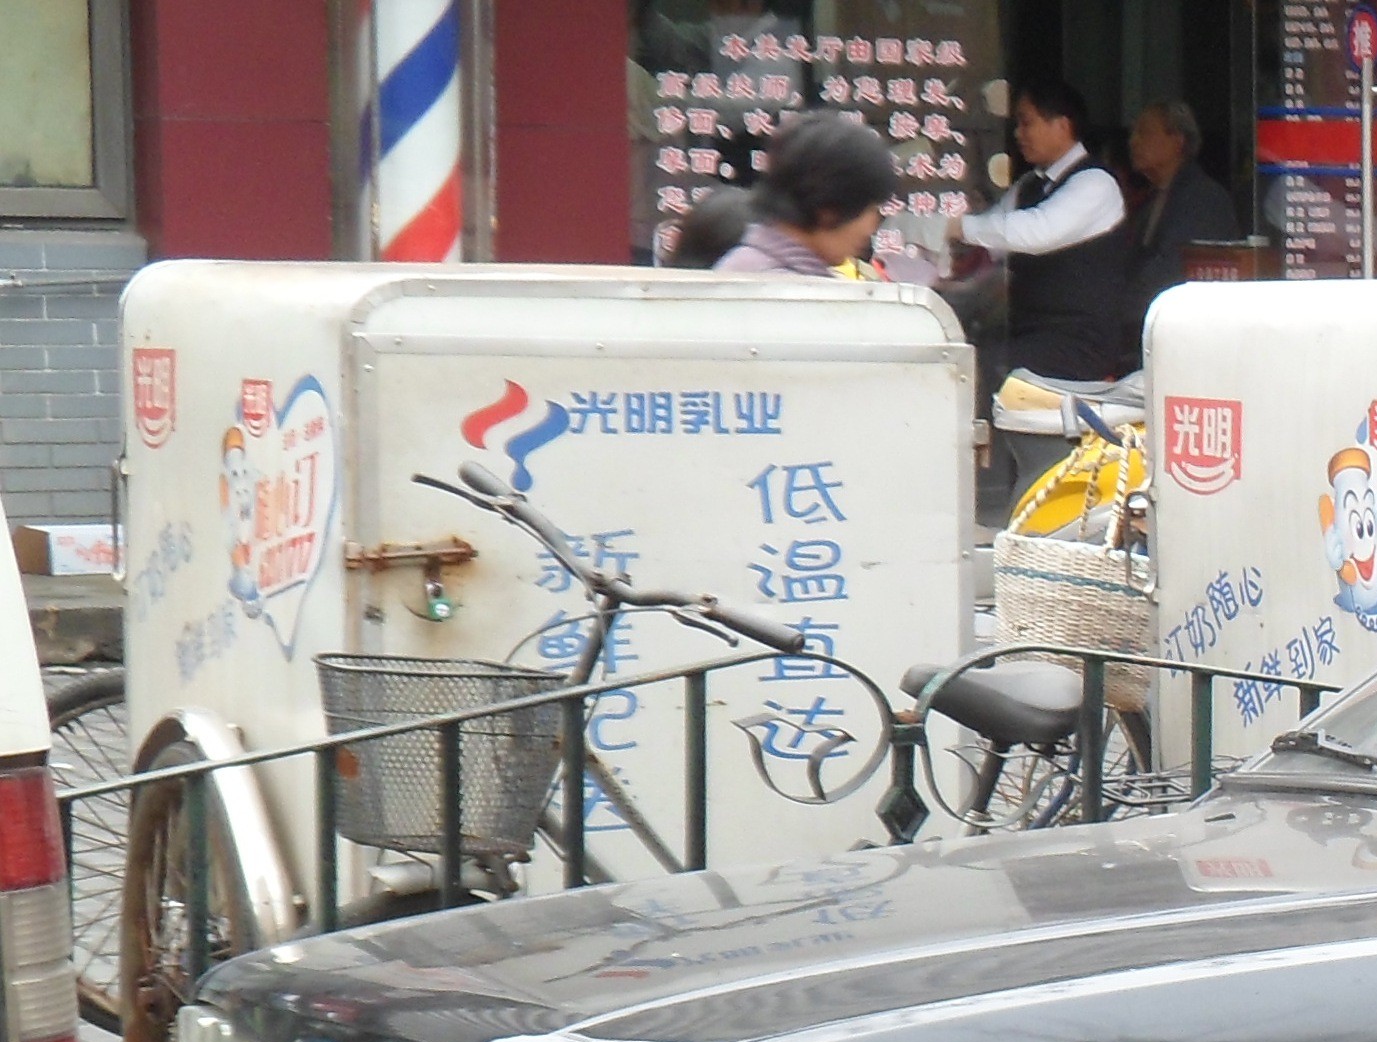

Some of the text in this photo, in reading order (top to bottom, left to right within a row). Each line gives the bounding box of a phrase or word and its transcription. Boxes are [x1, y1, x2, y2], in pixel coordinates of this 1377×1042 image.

[567, 390, 782, 434] 光明乳业
[1172, 404, 1233, 458] 光明
[747, 461, 849, 760] 低温直达
[1233, 616, 1340, 728] 新鲜到家
